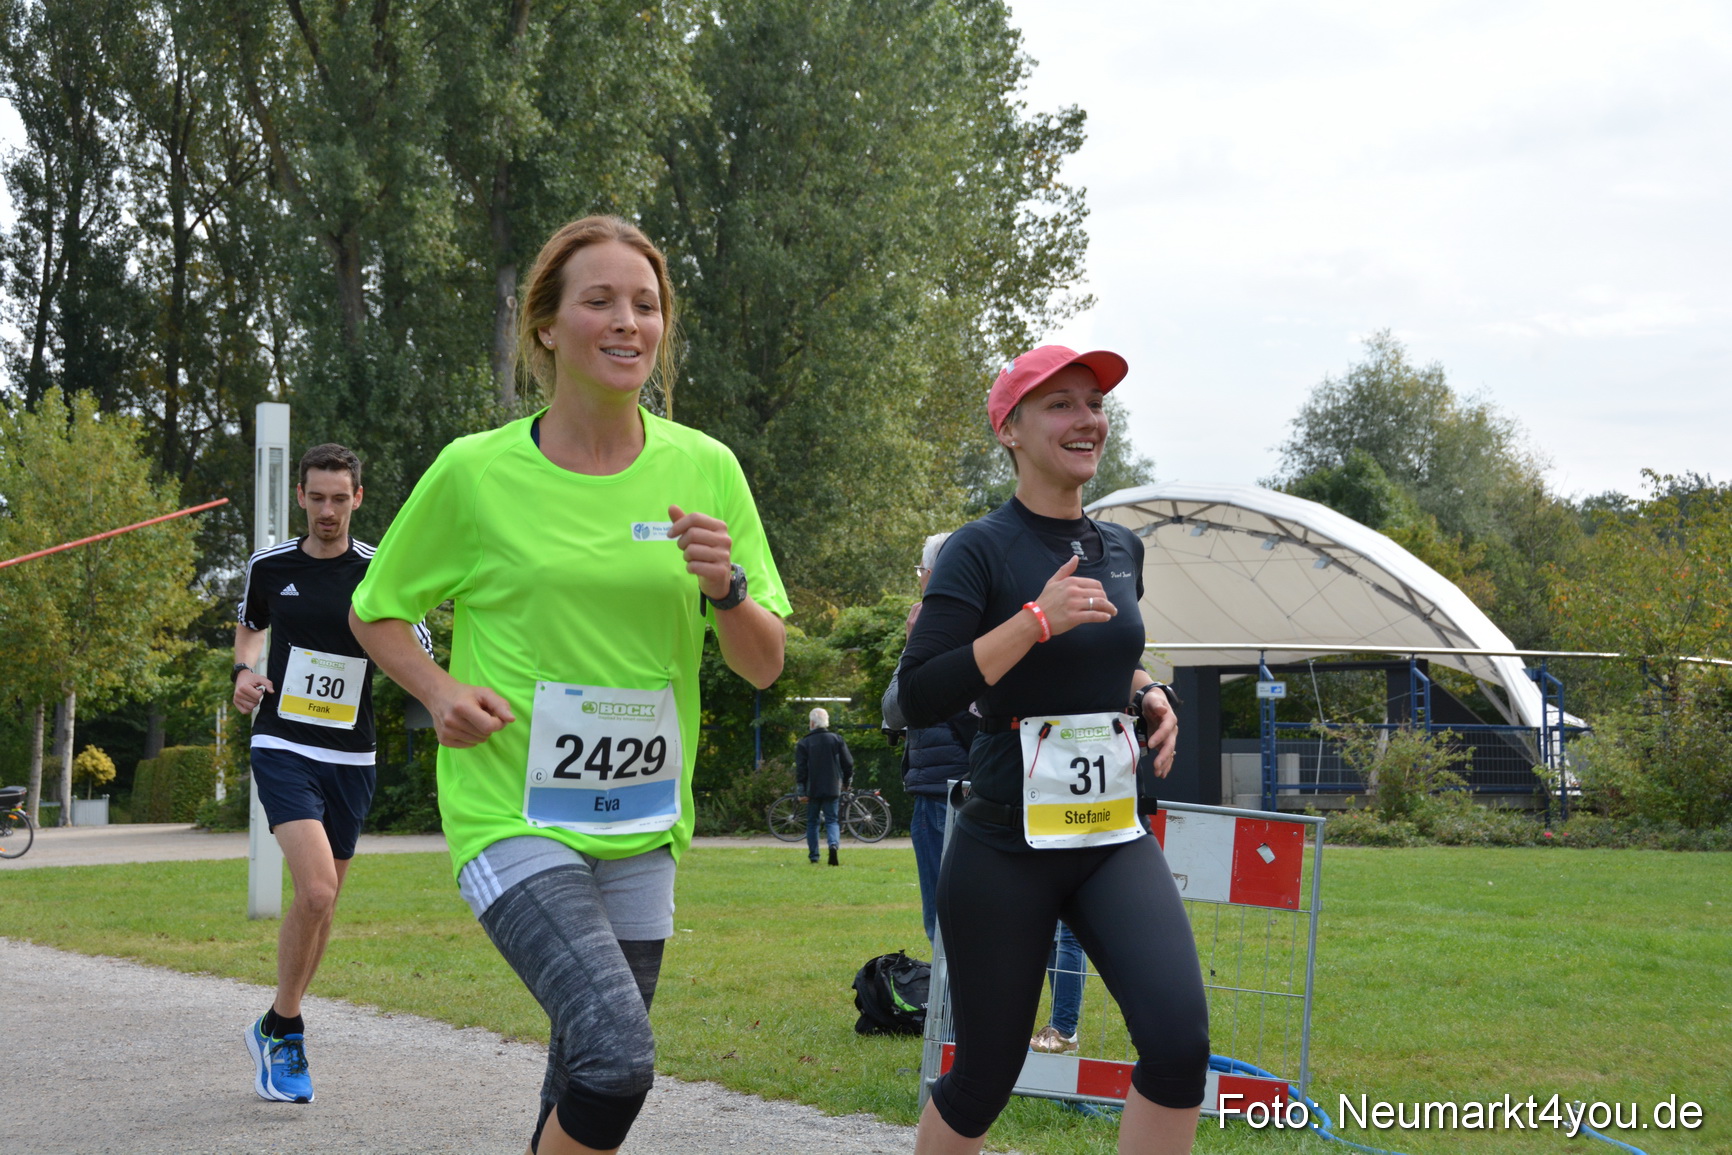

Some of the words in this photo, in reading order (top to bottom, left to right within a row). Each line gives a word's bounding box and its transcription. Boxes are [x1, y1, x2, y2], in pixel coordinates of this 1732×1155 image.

[318, 659, 346, 670] BOCK
[305, 673, 345, 699] 130
[308, 703, 331, 714] Frank
[599, 702, 656, 717] BOCK
[1075, 726, 1111, 739] BOCK
[553, 734, 667, 780] 2429
[536, 772, 542, 781] C
[1069, 755, 1106, 795] 31
[594, 797, 620, 812] Eva
[1065, 808, 1111, 824] Stefanie
